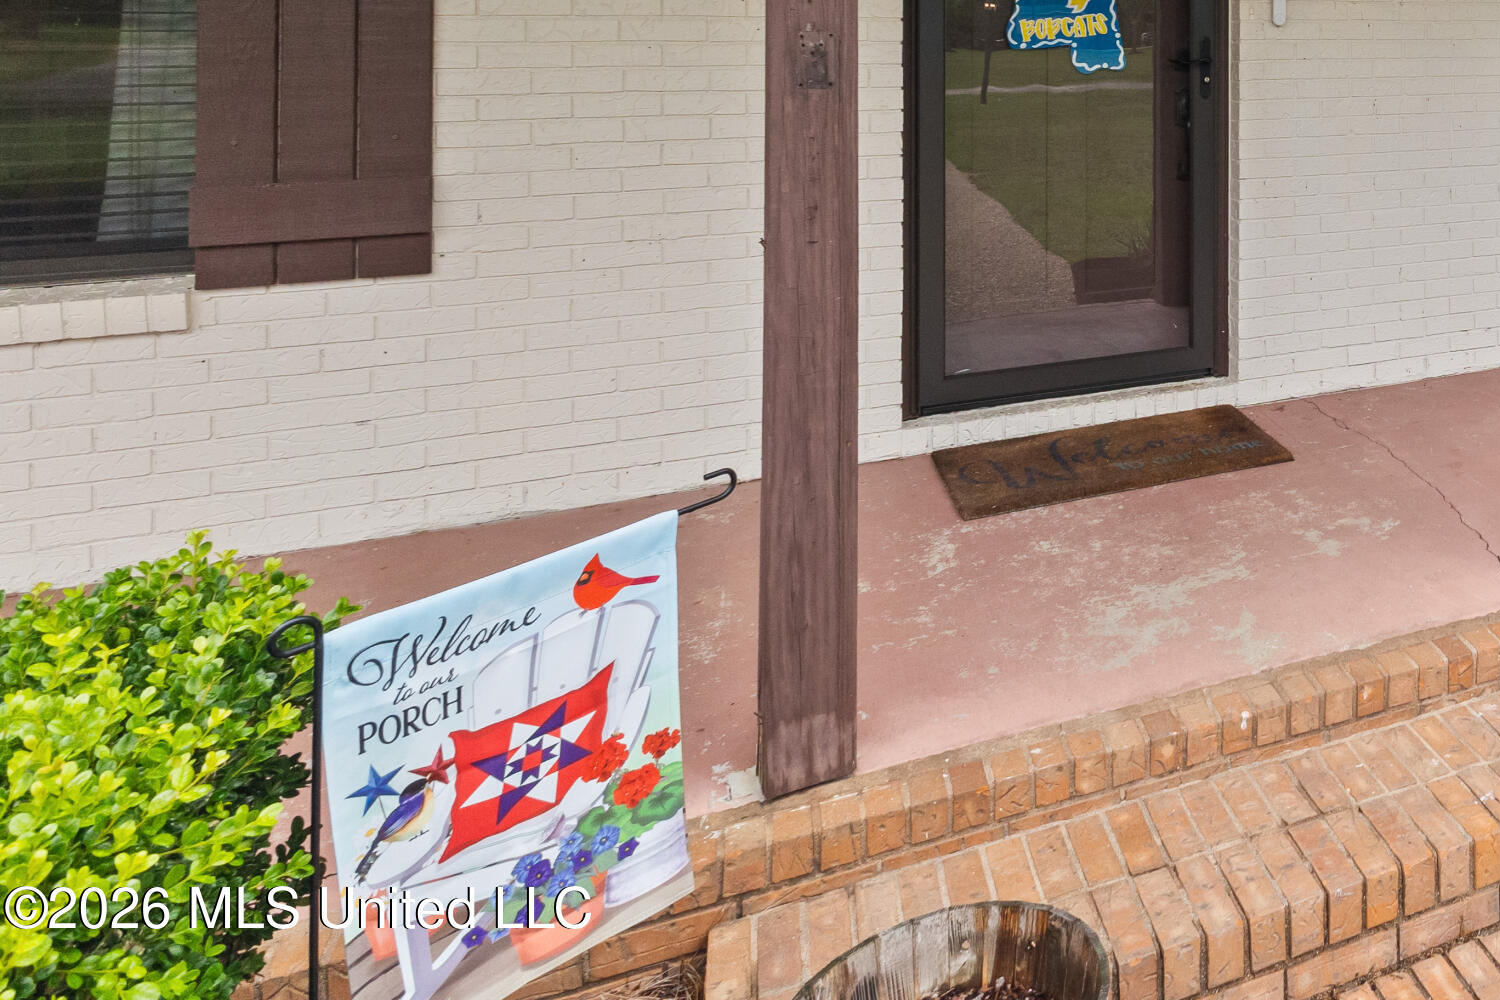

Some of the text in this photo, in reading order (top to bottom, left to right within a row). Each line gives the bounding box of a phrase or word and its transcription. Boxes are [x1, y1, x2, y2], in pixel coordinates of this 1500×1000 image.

[1019, 13, 1108, 42] BOBCATS
[347, 606, 542, 691] Welcome
[393, 668, 459, 705] to our
[357, 685, 464, 755] PORCH
